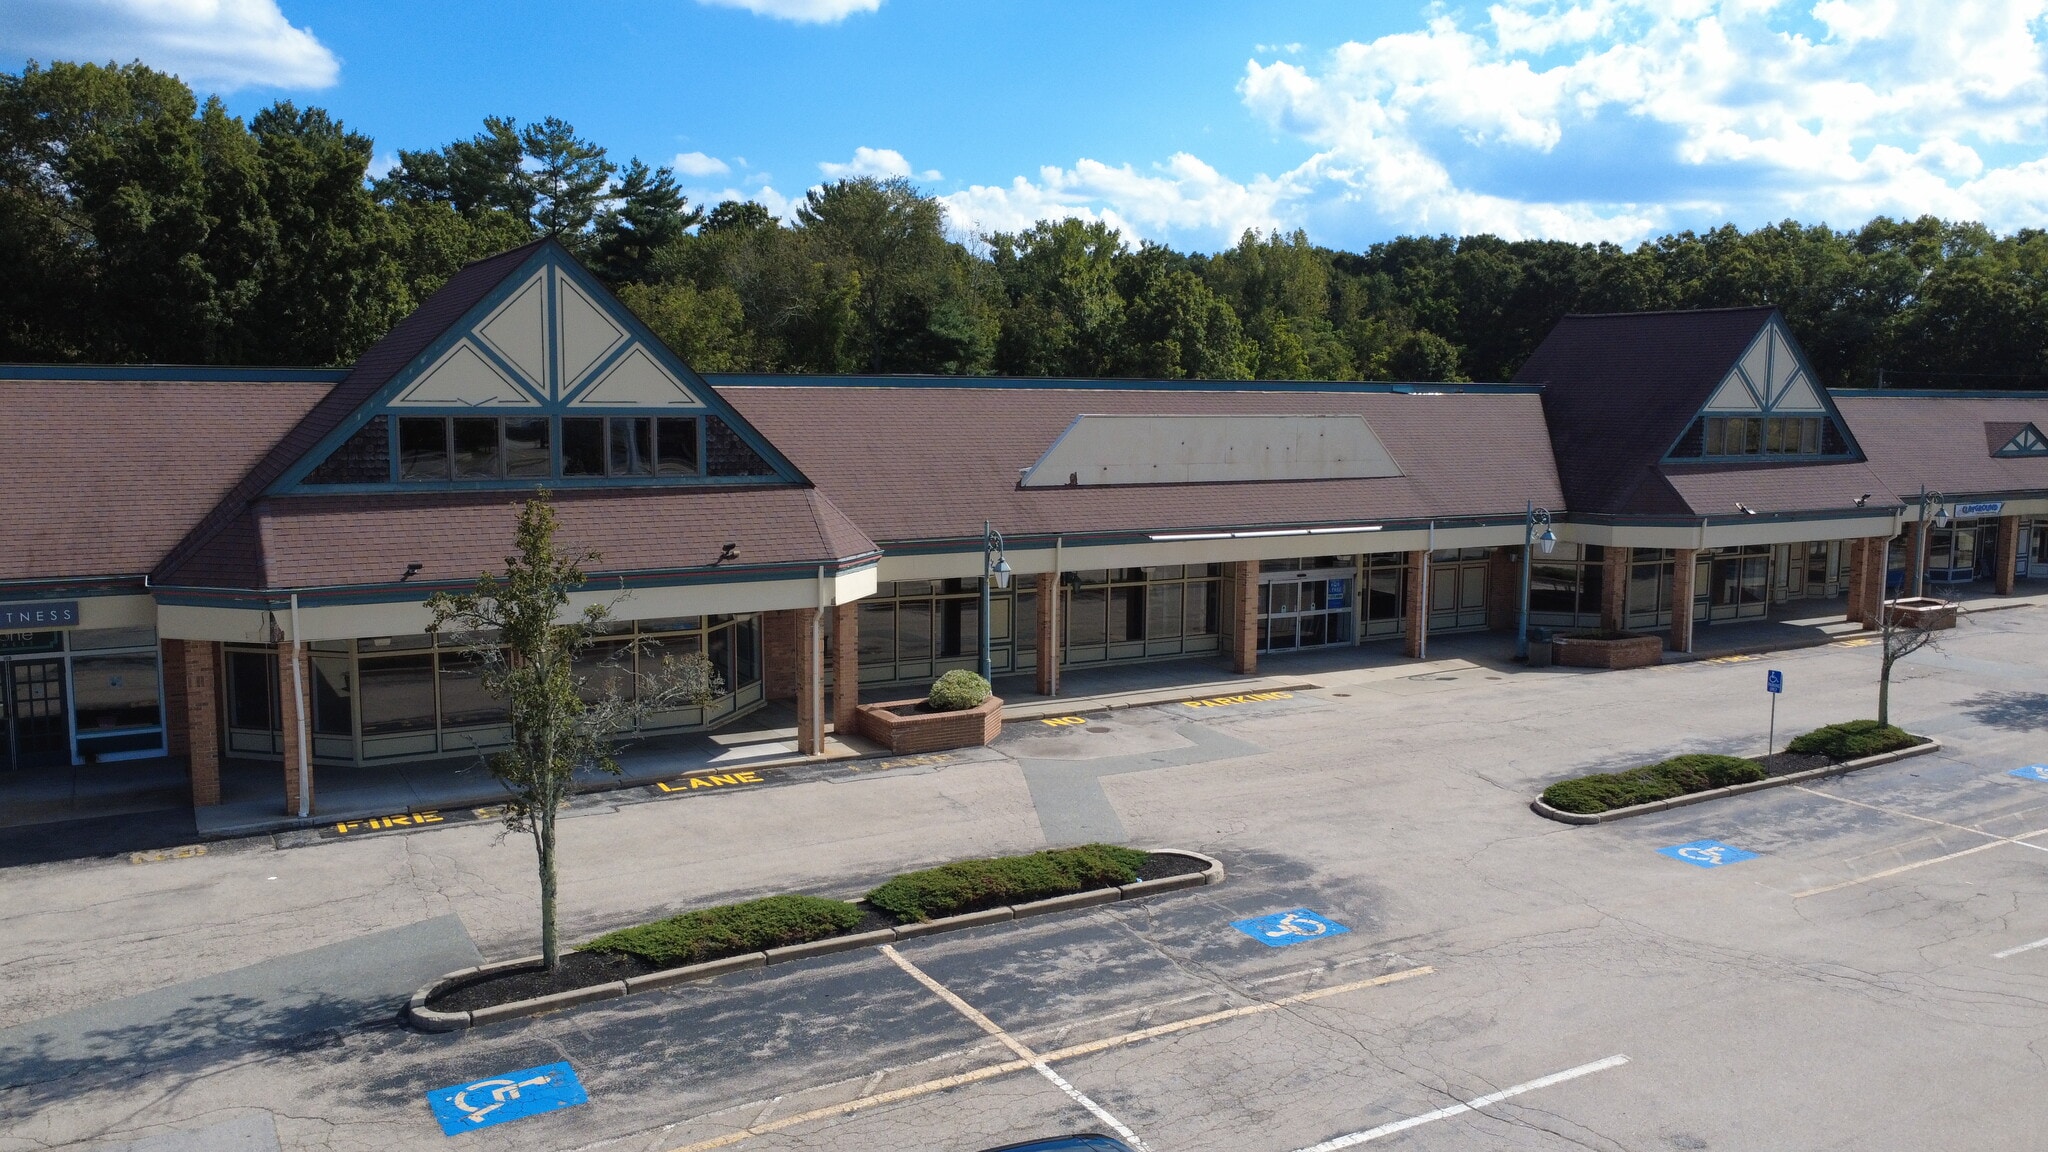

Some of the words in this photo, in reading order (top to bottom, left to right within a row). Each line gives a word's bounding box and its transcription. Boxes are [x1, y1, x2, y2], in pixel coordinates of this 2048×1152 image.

[6, 609, 71, 623] TNESS
[1041, 716, 1086, 727] NO
[1182, 691, 1294, 710] PARKING
[336, 810, 444, 833] FIRE
[656, 771, 764, 793] LANE
